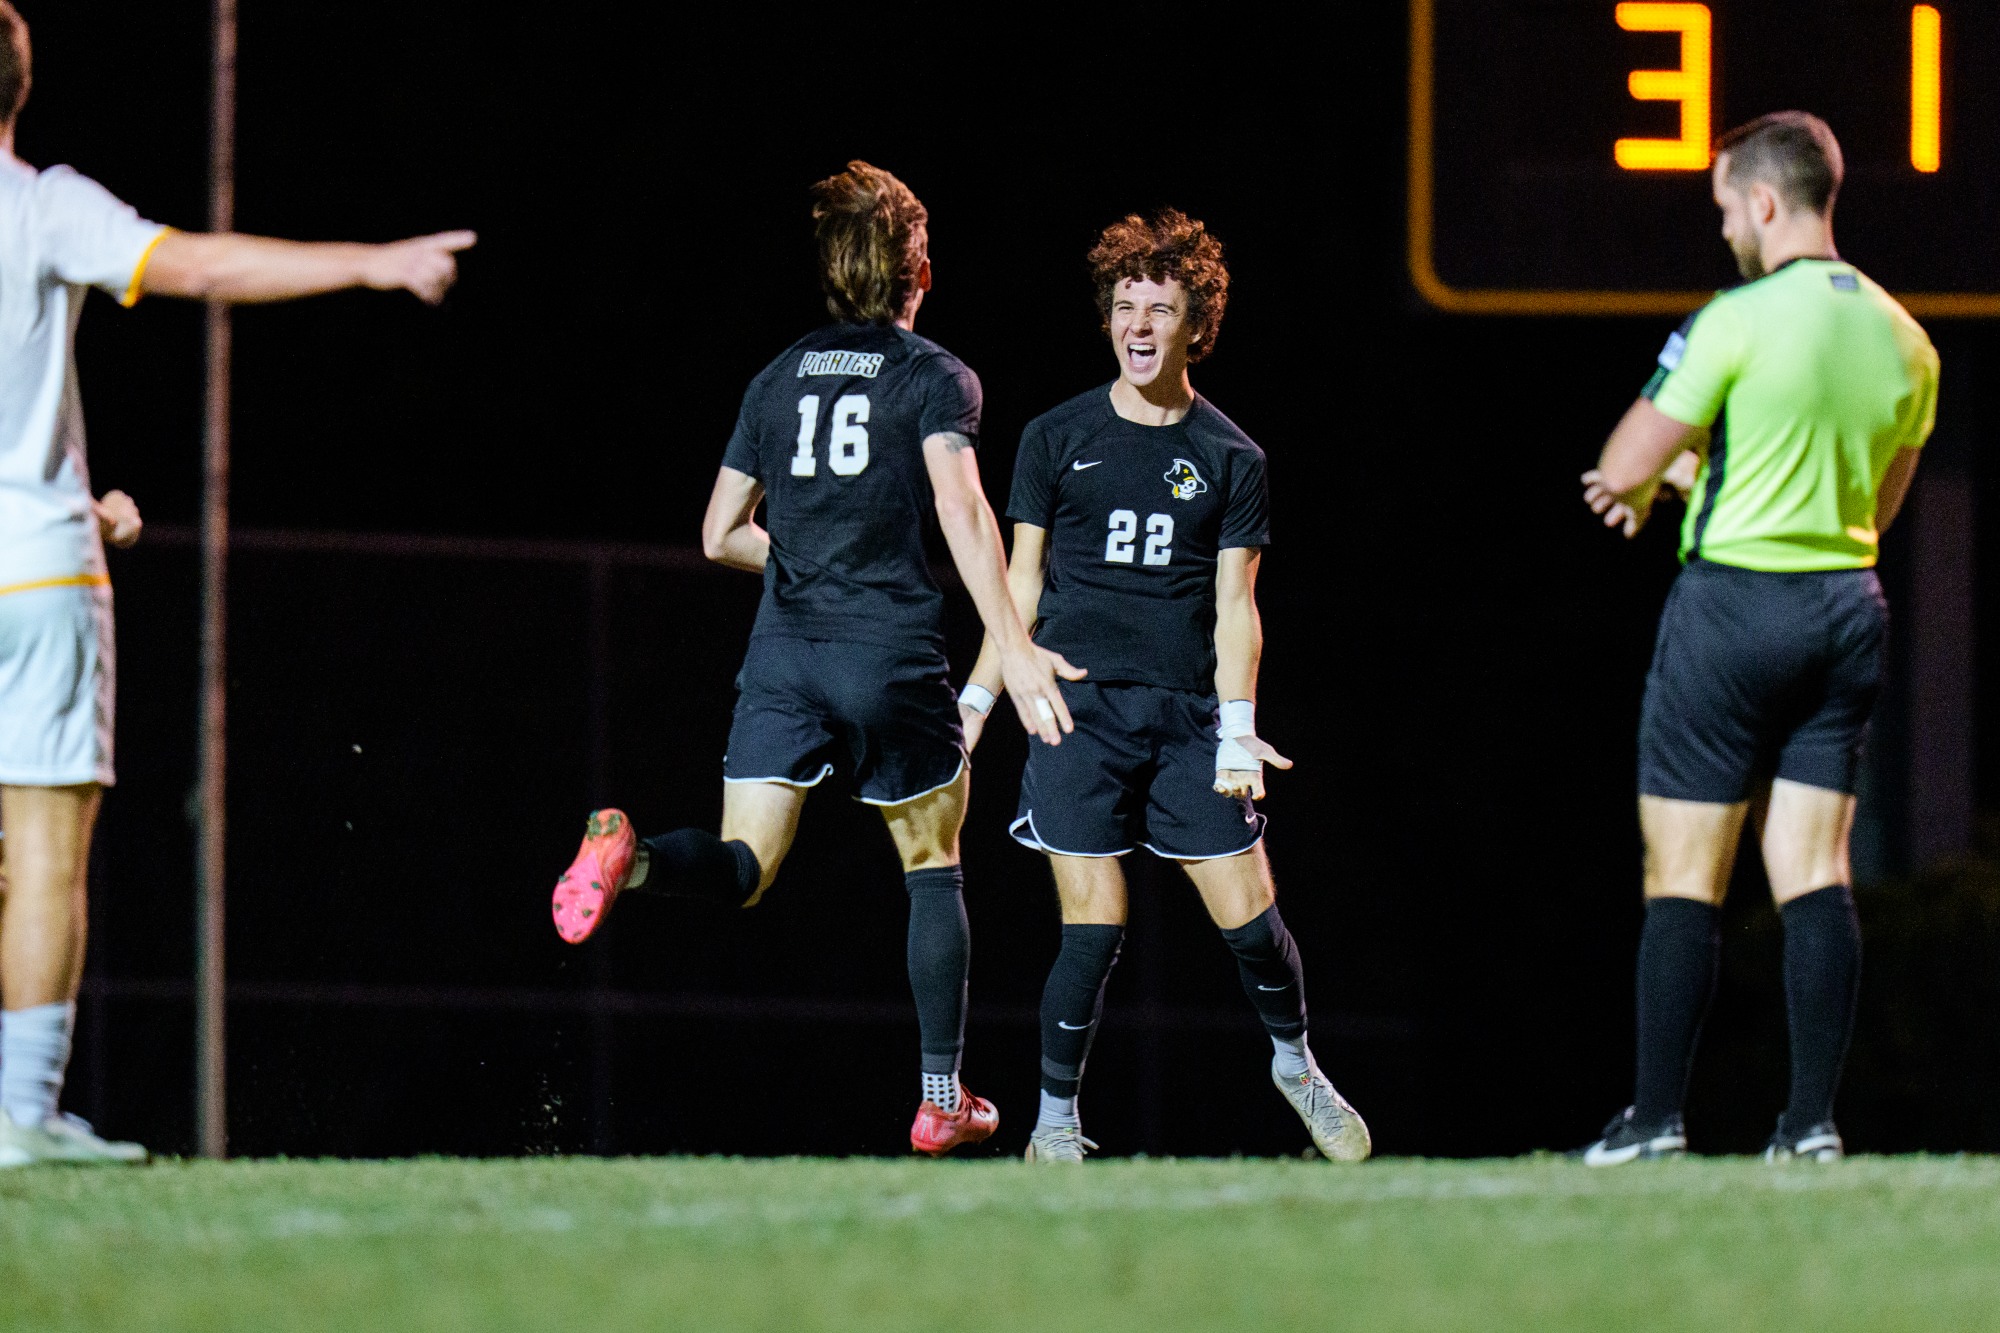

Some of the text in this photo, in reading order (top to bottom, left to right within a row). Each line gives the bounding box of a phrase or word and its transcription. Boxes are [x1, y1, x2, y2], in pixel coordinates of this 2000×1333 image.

[1615, 2, 1941, 172] 3 1
[797, 350, 885, 378] PIRATES
[791, 394, 871, 477] 16
[1104, 509, 1175, 566] 22
